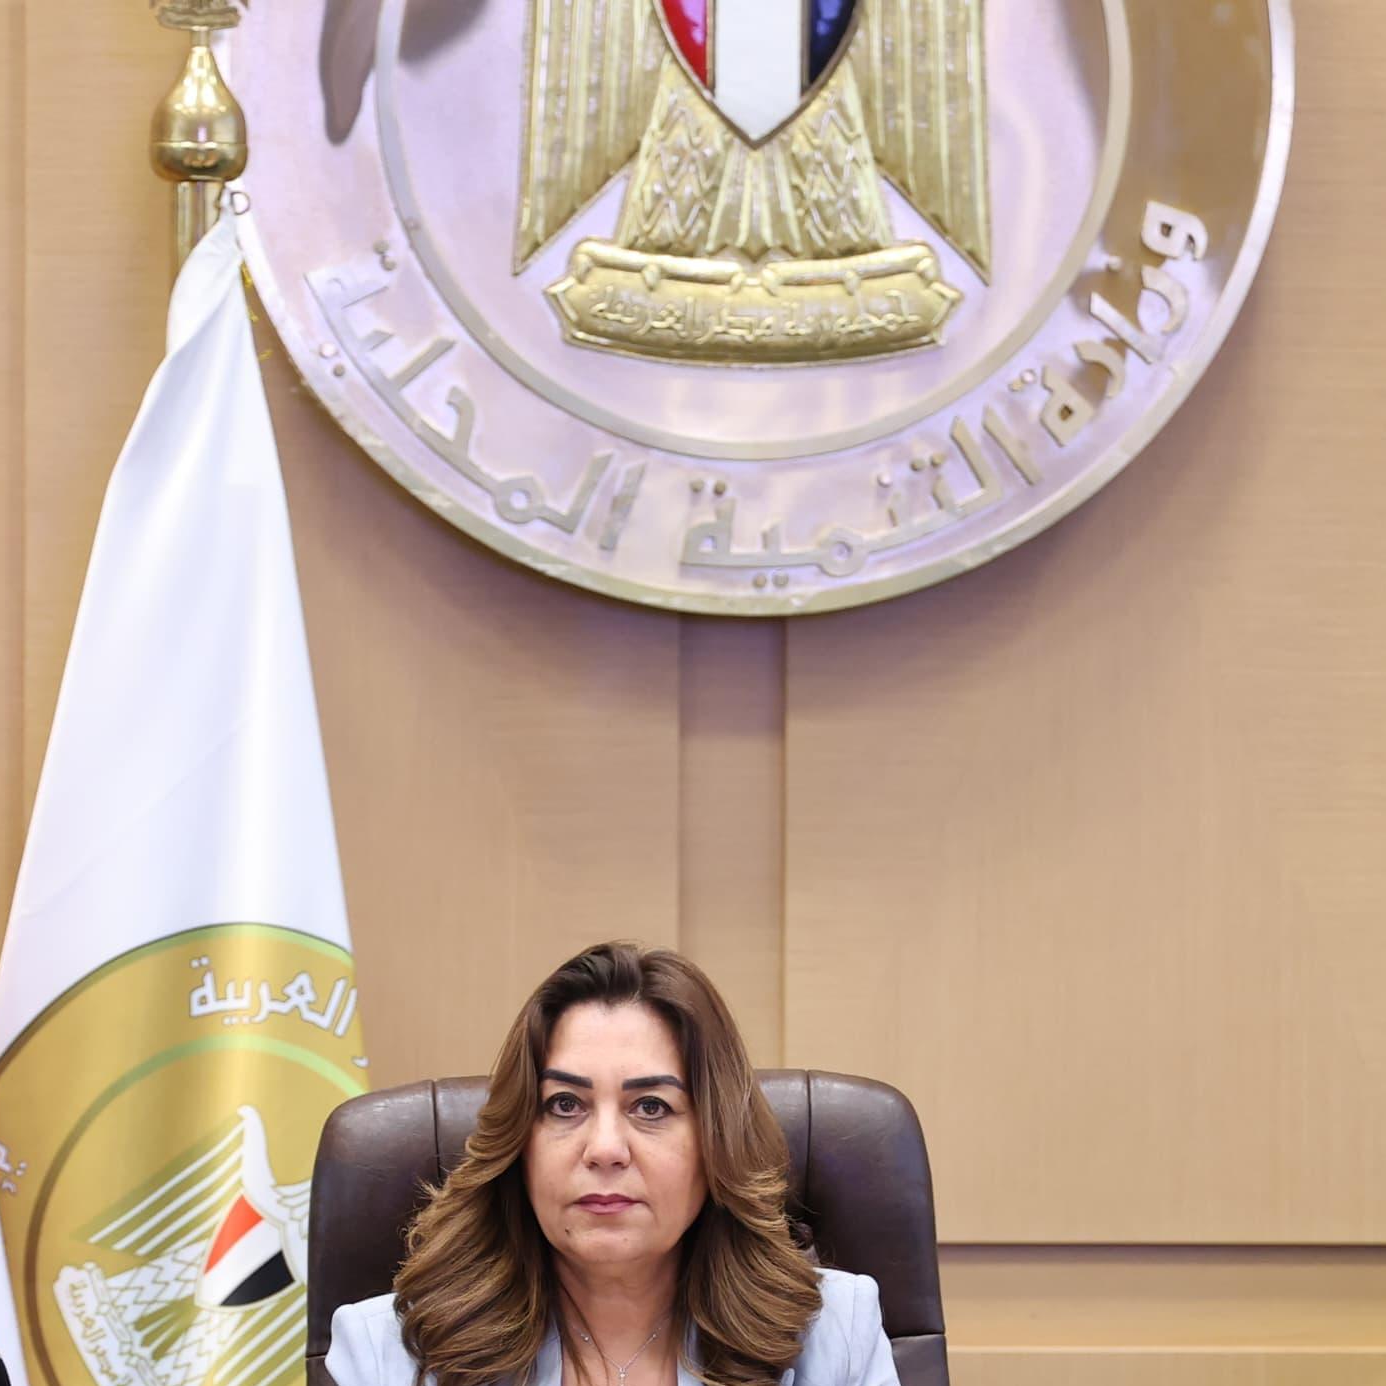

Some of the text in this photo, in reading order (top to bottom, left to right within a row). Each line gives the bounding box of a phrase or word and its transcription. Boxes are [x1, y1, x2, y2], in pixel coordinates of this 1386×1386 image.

[303, 199, 1208, 589] وزارة التنمية المحلية
[189, 955, 358, 1037] العربية
